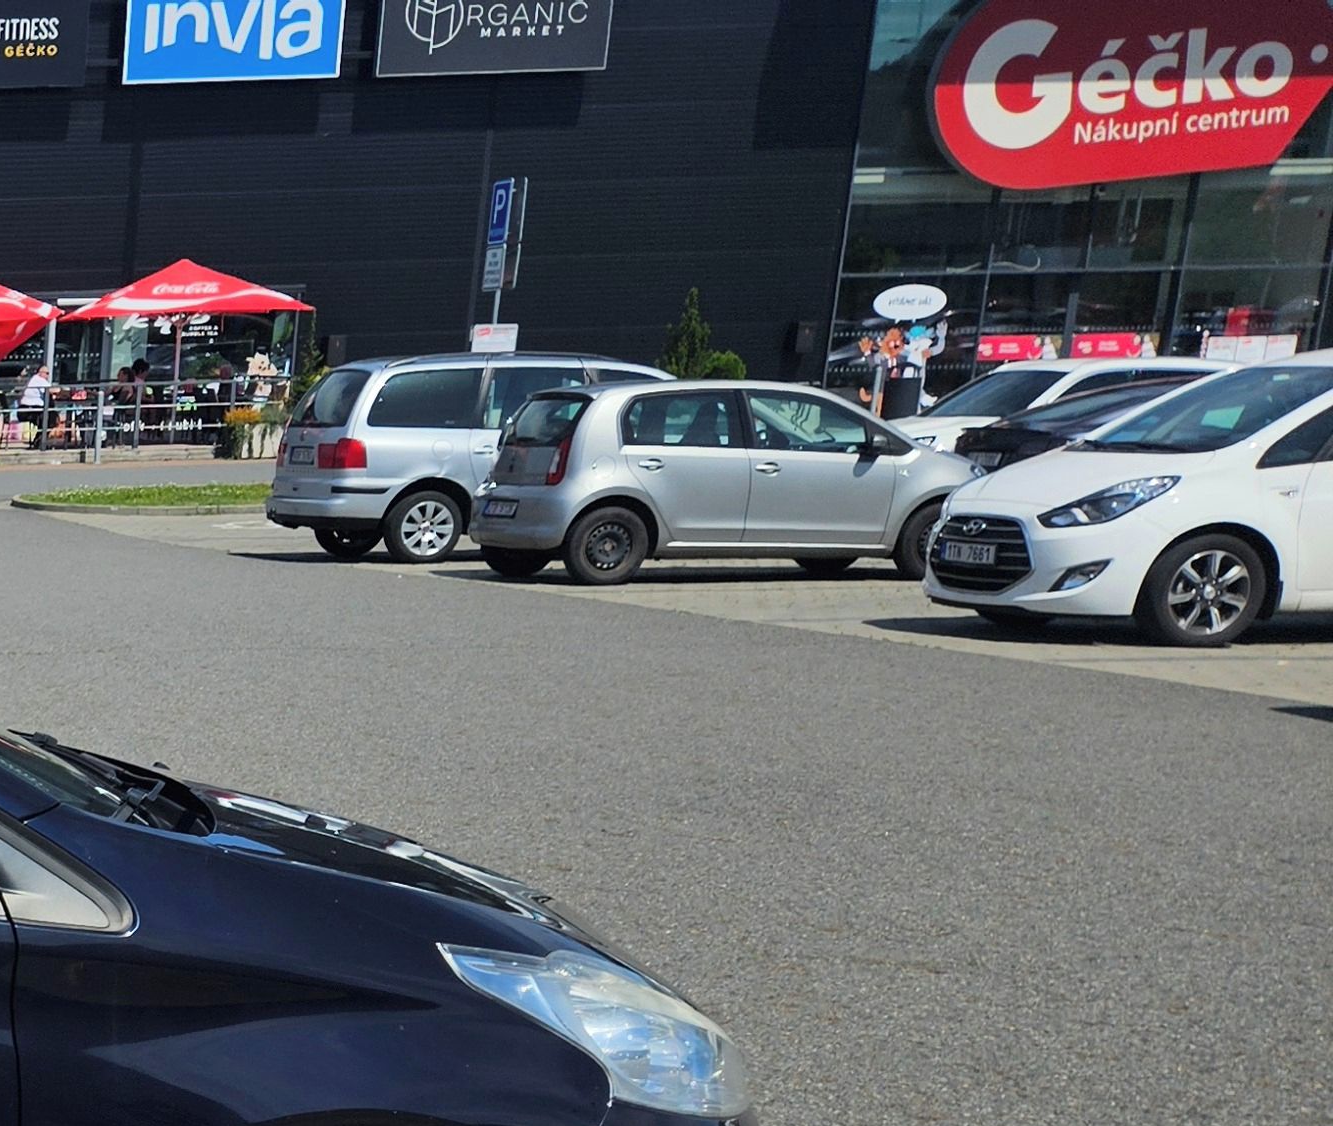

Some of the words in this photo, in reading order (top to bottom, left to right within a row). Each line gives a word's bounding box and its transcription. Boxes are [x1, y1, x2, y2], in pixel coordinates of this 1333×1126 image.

[480, 25, 565, 38] MARKET
[4, 43, 58, 57] GÉČKO
[963, 19, 1294, 150] Géčko
[1074, 112, 1178, 145] Nákupní
[1186, 105, 1289, 133] centrum
[493, 189, 506, 224] P
